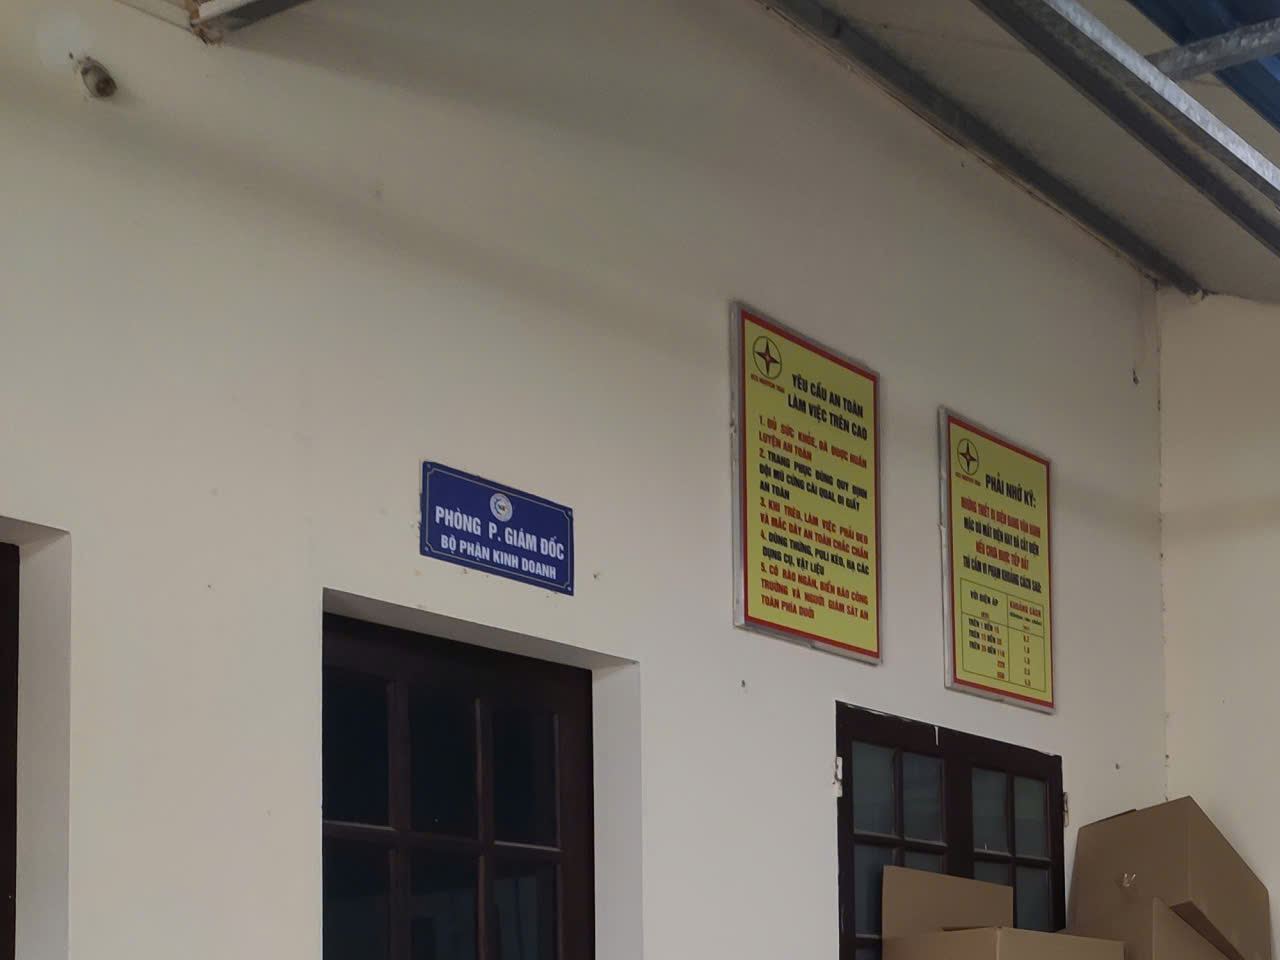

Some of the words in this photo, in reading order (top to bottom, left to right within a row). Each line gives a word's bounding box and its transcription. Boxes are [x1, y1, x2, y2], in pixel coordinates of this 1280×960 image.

[792, 374, 808, 392] YÊU
[810, 381, 827, 401] CẦU
[829, 391, 840, 408] AN
[843, 397, 863, 418] TOÀN
[760, 416, 765, 426] 1.
[788, 394, 806, 413] LÀM
[809, 403, 827, 423] VIỆC
[829, 412, 849, 432] TRÊN
[852, 423, 867, 440] CAO
[783, 441, 792, 453] AN
[795, 445, 812, 461] TOÀN
[759, 448, 765, 458] 2.
[768, 451, 790, 468] TRANG
[837, 479, 848, 491] QUY
[760, 480, 769, 493] AN
[772, 484, 789, 500] TOÀN
[985, 472, 1004, 495] PHẢI
[1006, 483, 1022, 502] NHỚ
[760, 496, 766, 508] 3.
[768, 500, 780, 512] KHI
[804, 512, 818, 527] LÀM
[822, 519, 836, 533] VIỆC
[760, 512, 769, 525] VÀ
[804, 528, 813, 540] AN
[815, 532, 831, 547] TOÀN
[435, 506, 481, 536] PHÒNG
[488, 522, 501, 541] P.
[505, 527, 537, 552] GIÁM
[540, 536, 564, 560] ĐỐC
[441, 535, 456, 554] BỘ
[460, 540, 490, 561] PHẬN
[493, 549, 519, 569] KINH
[522, 558, 556, 580] DOANH
[761, 562, 767, 573] 5.
[797, 557, 808, 571] VẬT
[810, 562, 824, 576] LIỆU
[815, 548, 829, 562] PULI
[857, 562, 869, 575] CÁC
[761, 594, 779, 610] TOÀN
[781, 600, 797, 614] PHÍA
[792, 587, 800, 599] VÀ
[847, 604, 858, 618] SÁT
[860, 609, 868, 620] AN
